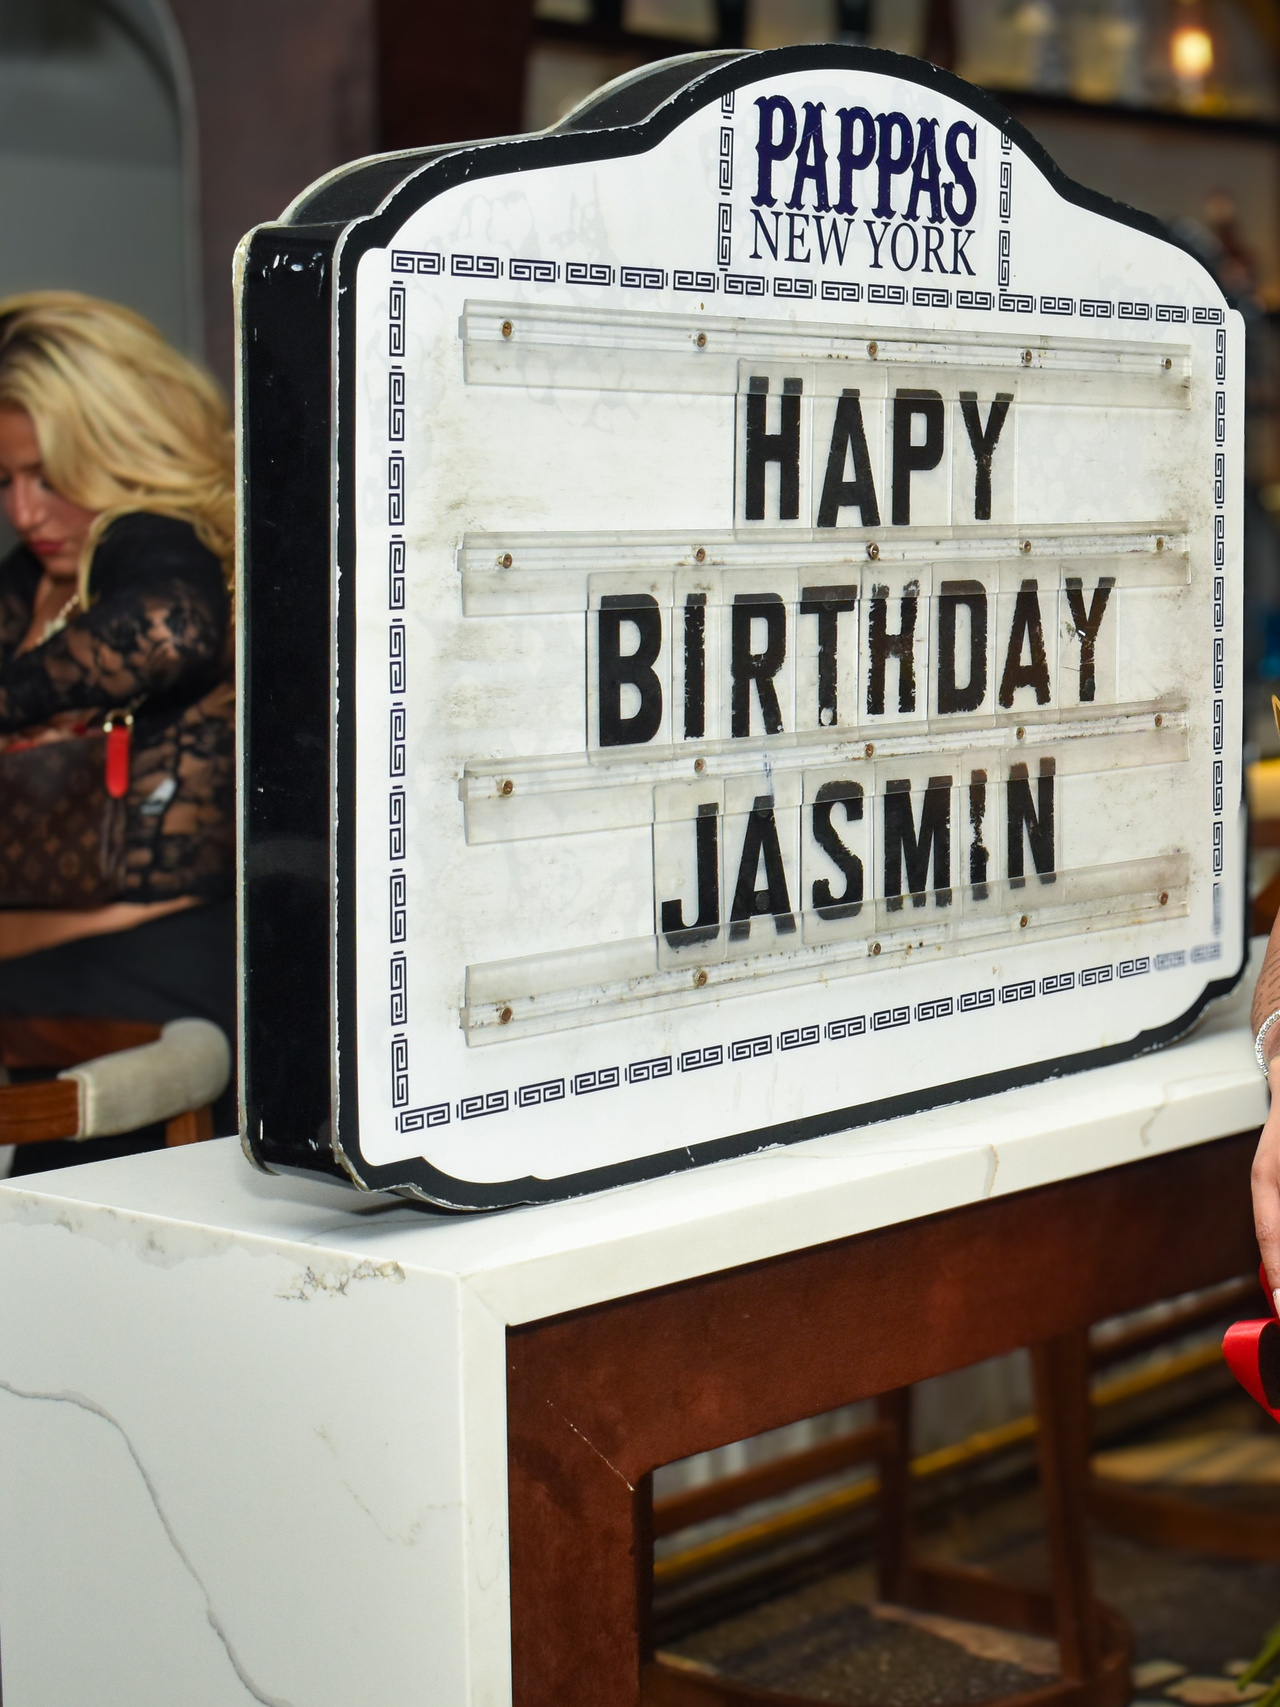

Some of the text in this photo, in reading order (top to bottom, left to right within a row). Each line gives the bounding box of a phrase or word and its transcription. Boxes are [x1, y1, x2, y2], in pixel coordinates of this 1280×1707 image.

[751, 95, 977, 227] PAPPAS
[749, 209, 977, 276] NEW YORK
[745, 376, 1015, 527] HAPY
[599, 576, 1116, 748] BIRTHDAY
[661, 757, 1057, 948] JASMIN
